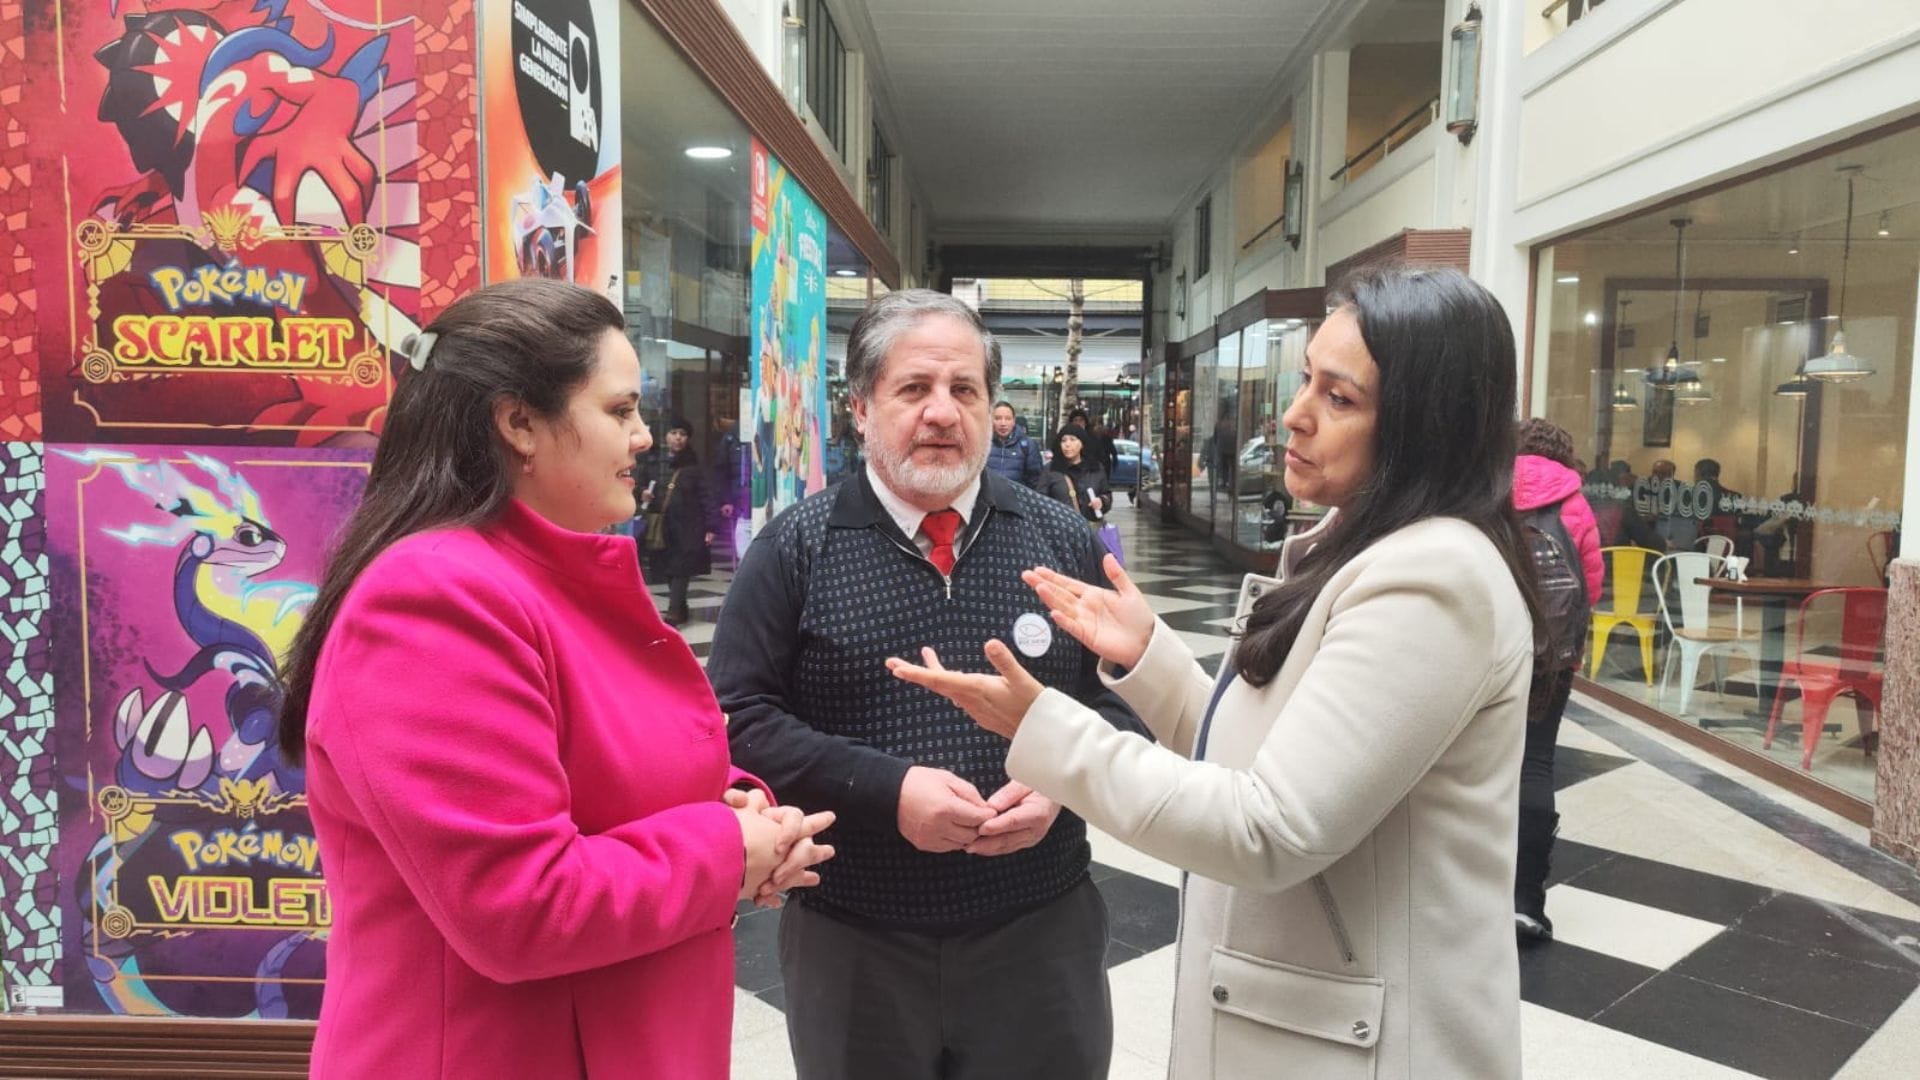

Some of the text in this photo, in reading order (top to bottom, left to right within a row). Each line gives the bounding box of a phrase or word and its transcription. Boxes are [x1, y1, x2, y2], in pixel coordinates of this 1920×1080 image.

[514, 0, 568, 58] SIMPLEMENTE
[520, 52, 568, 102] GENERACIÓN
[531, 37, 568, 80] LA NUEVA
[113, 315, 354, 367] SCARLET
[148, 875, 332, 925] VIOLET
